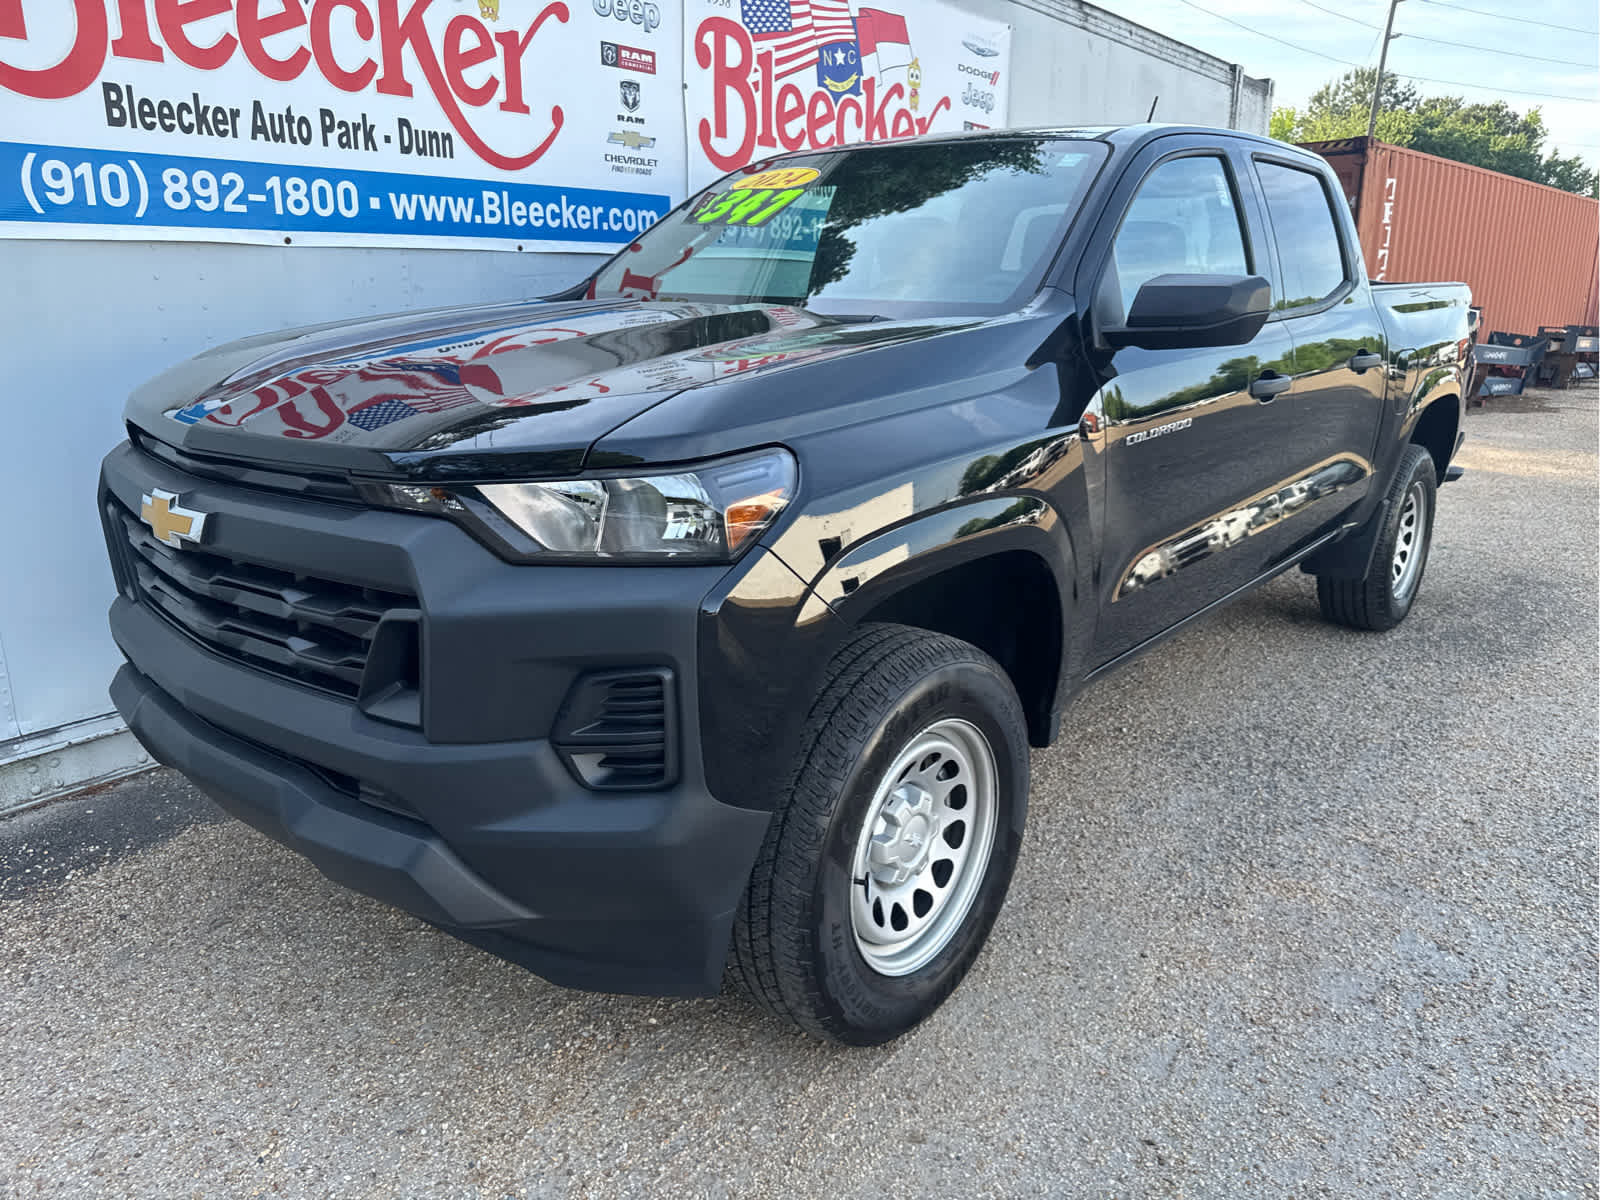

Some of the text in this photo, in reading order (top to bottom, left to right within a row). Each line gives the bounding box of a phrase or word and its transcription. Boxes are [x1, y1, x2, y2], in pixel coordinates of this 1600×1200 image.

[621, 49, 653, 63] RAM
[823, 49, 857, 66] N C
[958, 63, 994, 81] DODGE
[961, 82, 994, 114] Jeep
[102, 81, 240, 139] Bleecker
[250, 100, 313, 147] Auto
[320, 108, 378, 152] Park
[398, 117, 455, 159] Dunn
[616, 114, 645, 125] RAM
[604, 153, 658, 168] CHEVROLET
[21, 152, 659, 233] (910) 892-1800 www.Bleecker.com
[1125, 417, 1193, 447] COLORADO
